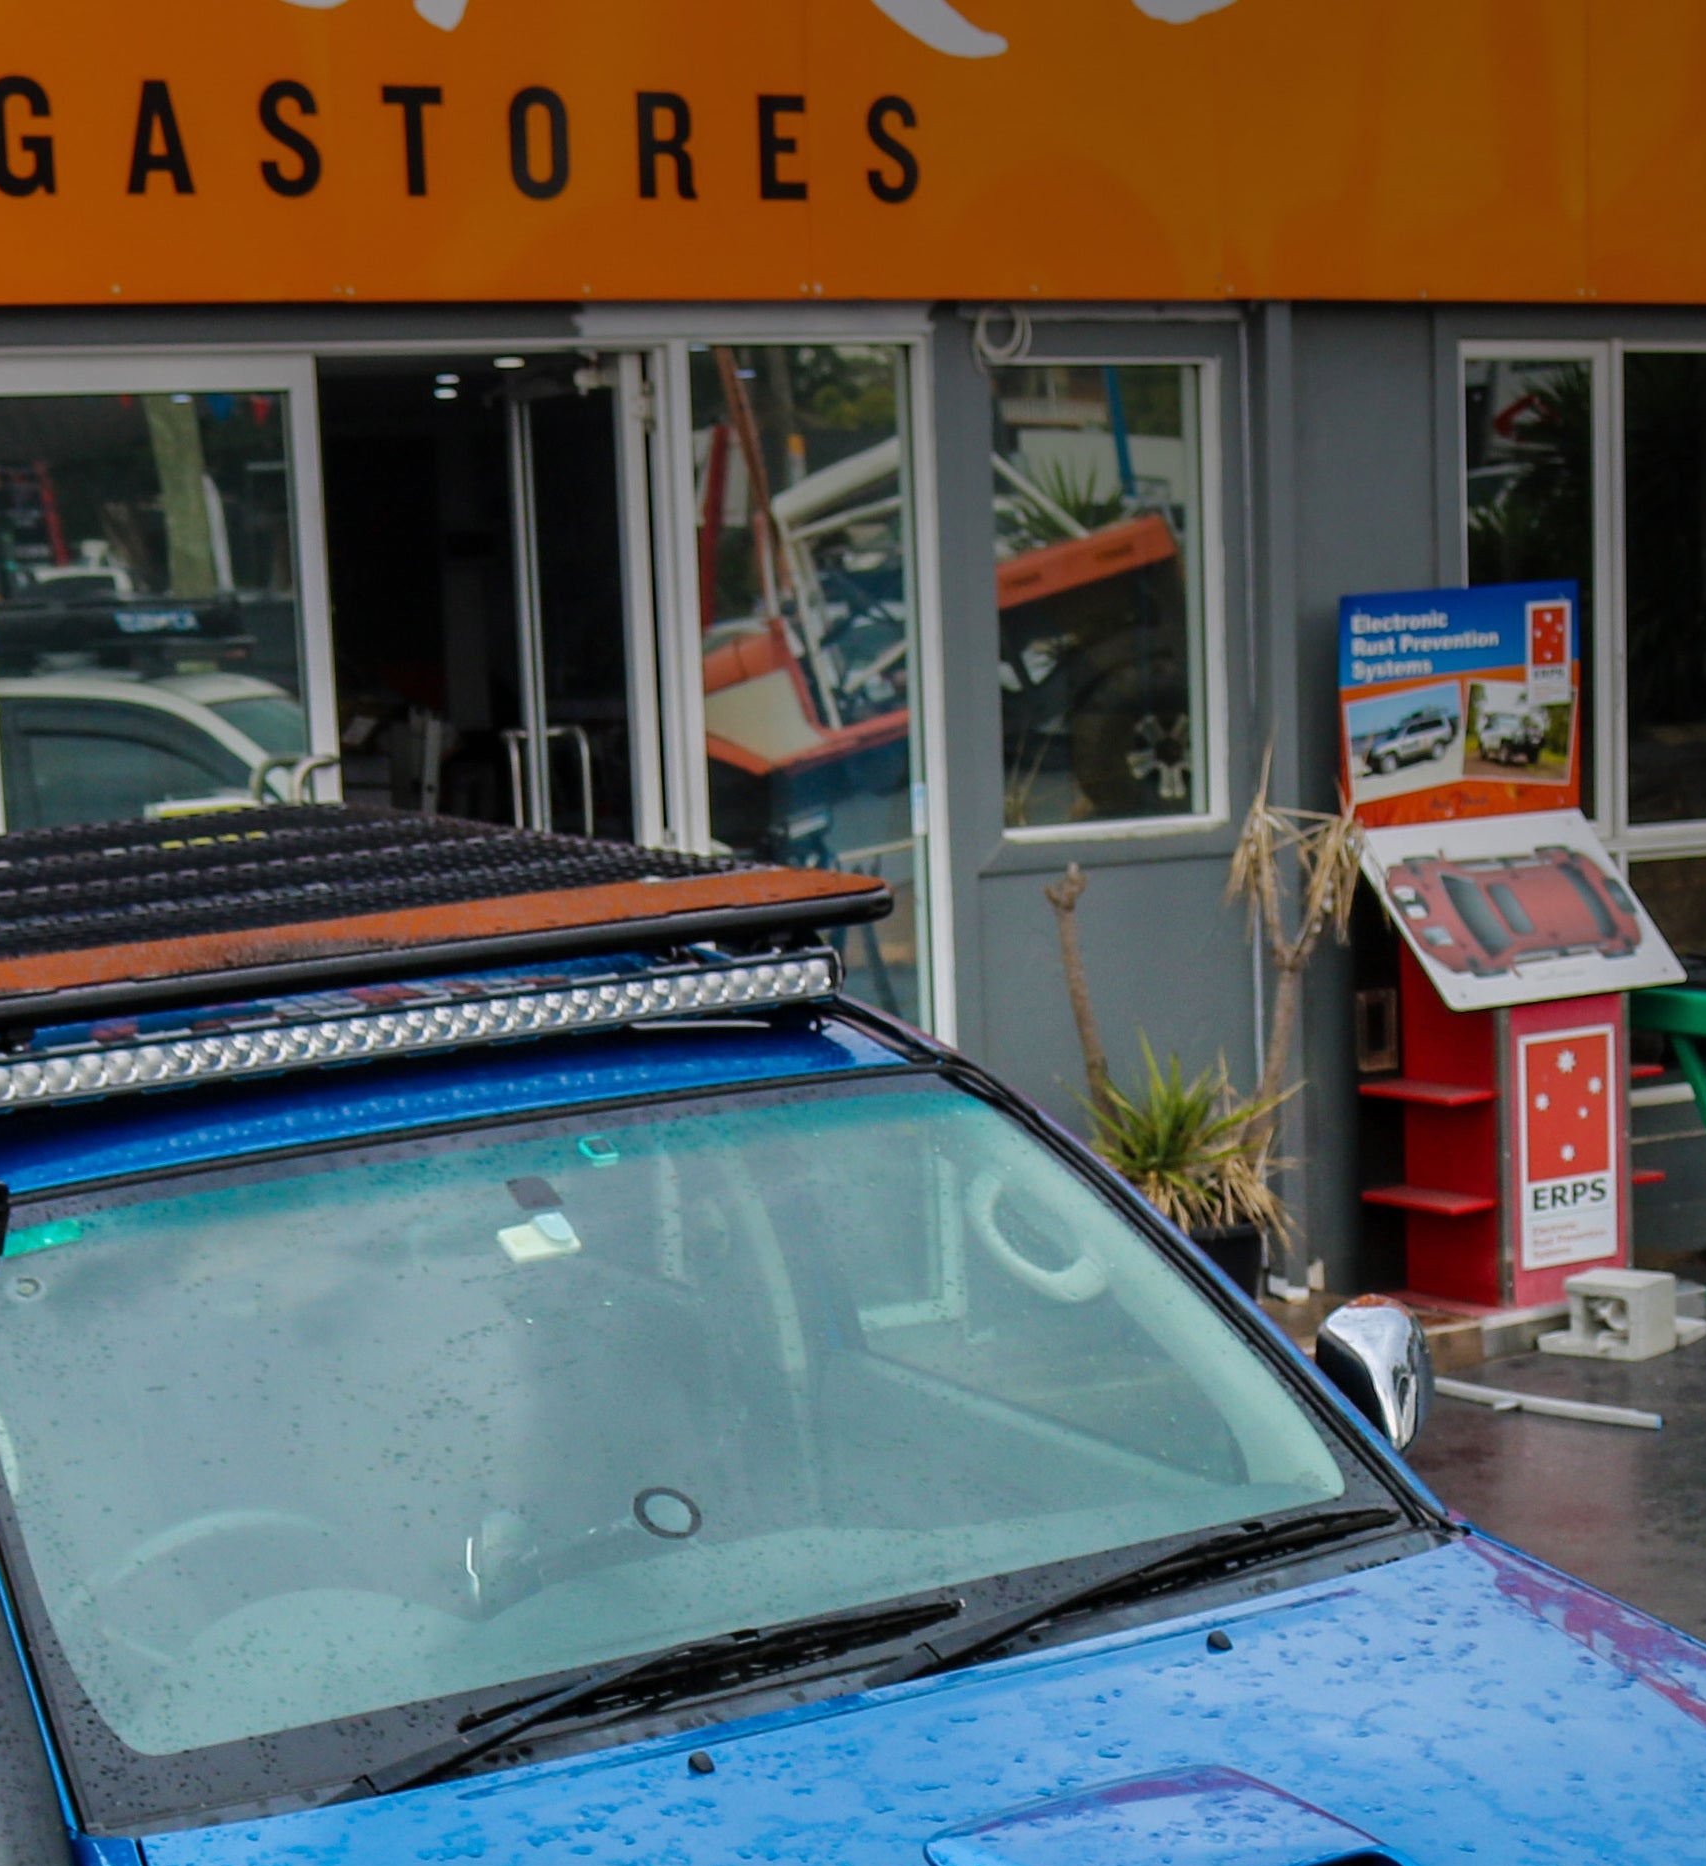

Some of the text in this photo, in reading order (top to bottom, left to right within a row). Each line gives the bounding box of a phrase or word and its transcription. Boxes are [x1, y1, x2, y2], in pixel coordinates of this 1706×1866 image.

[1350, 610, 1449, 635] Electronic
[1350, 631, 1500, 657] Rust Prevention
[1351, 658, 1434, 683] Systems
[1532, 1177, 1607, 1212] ERPS
